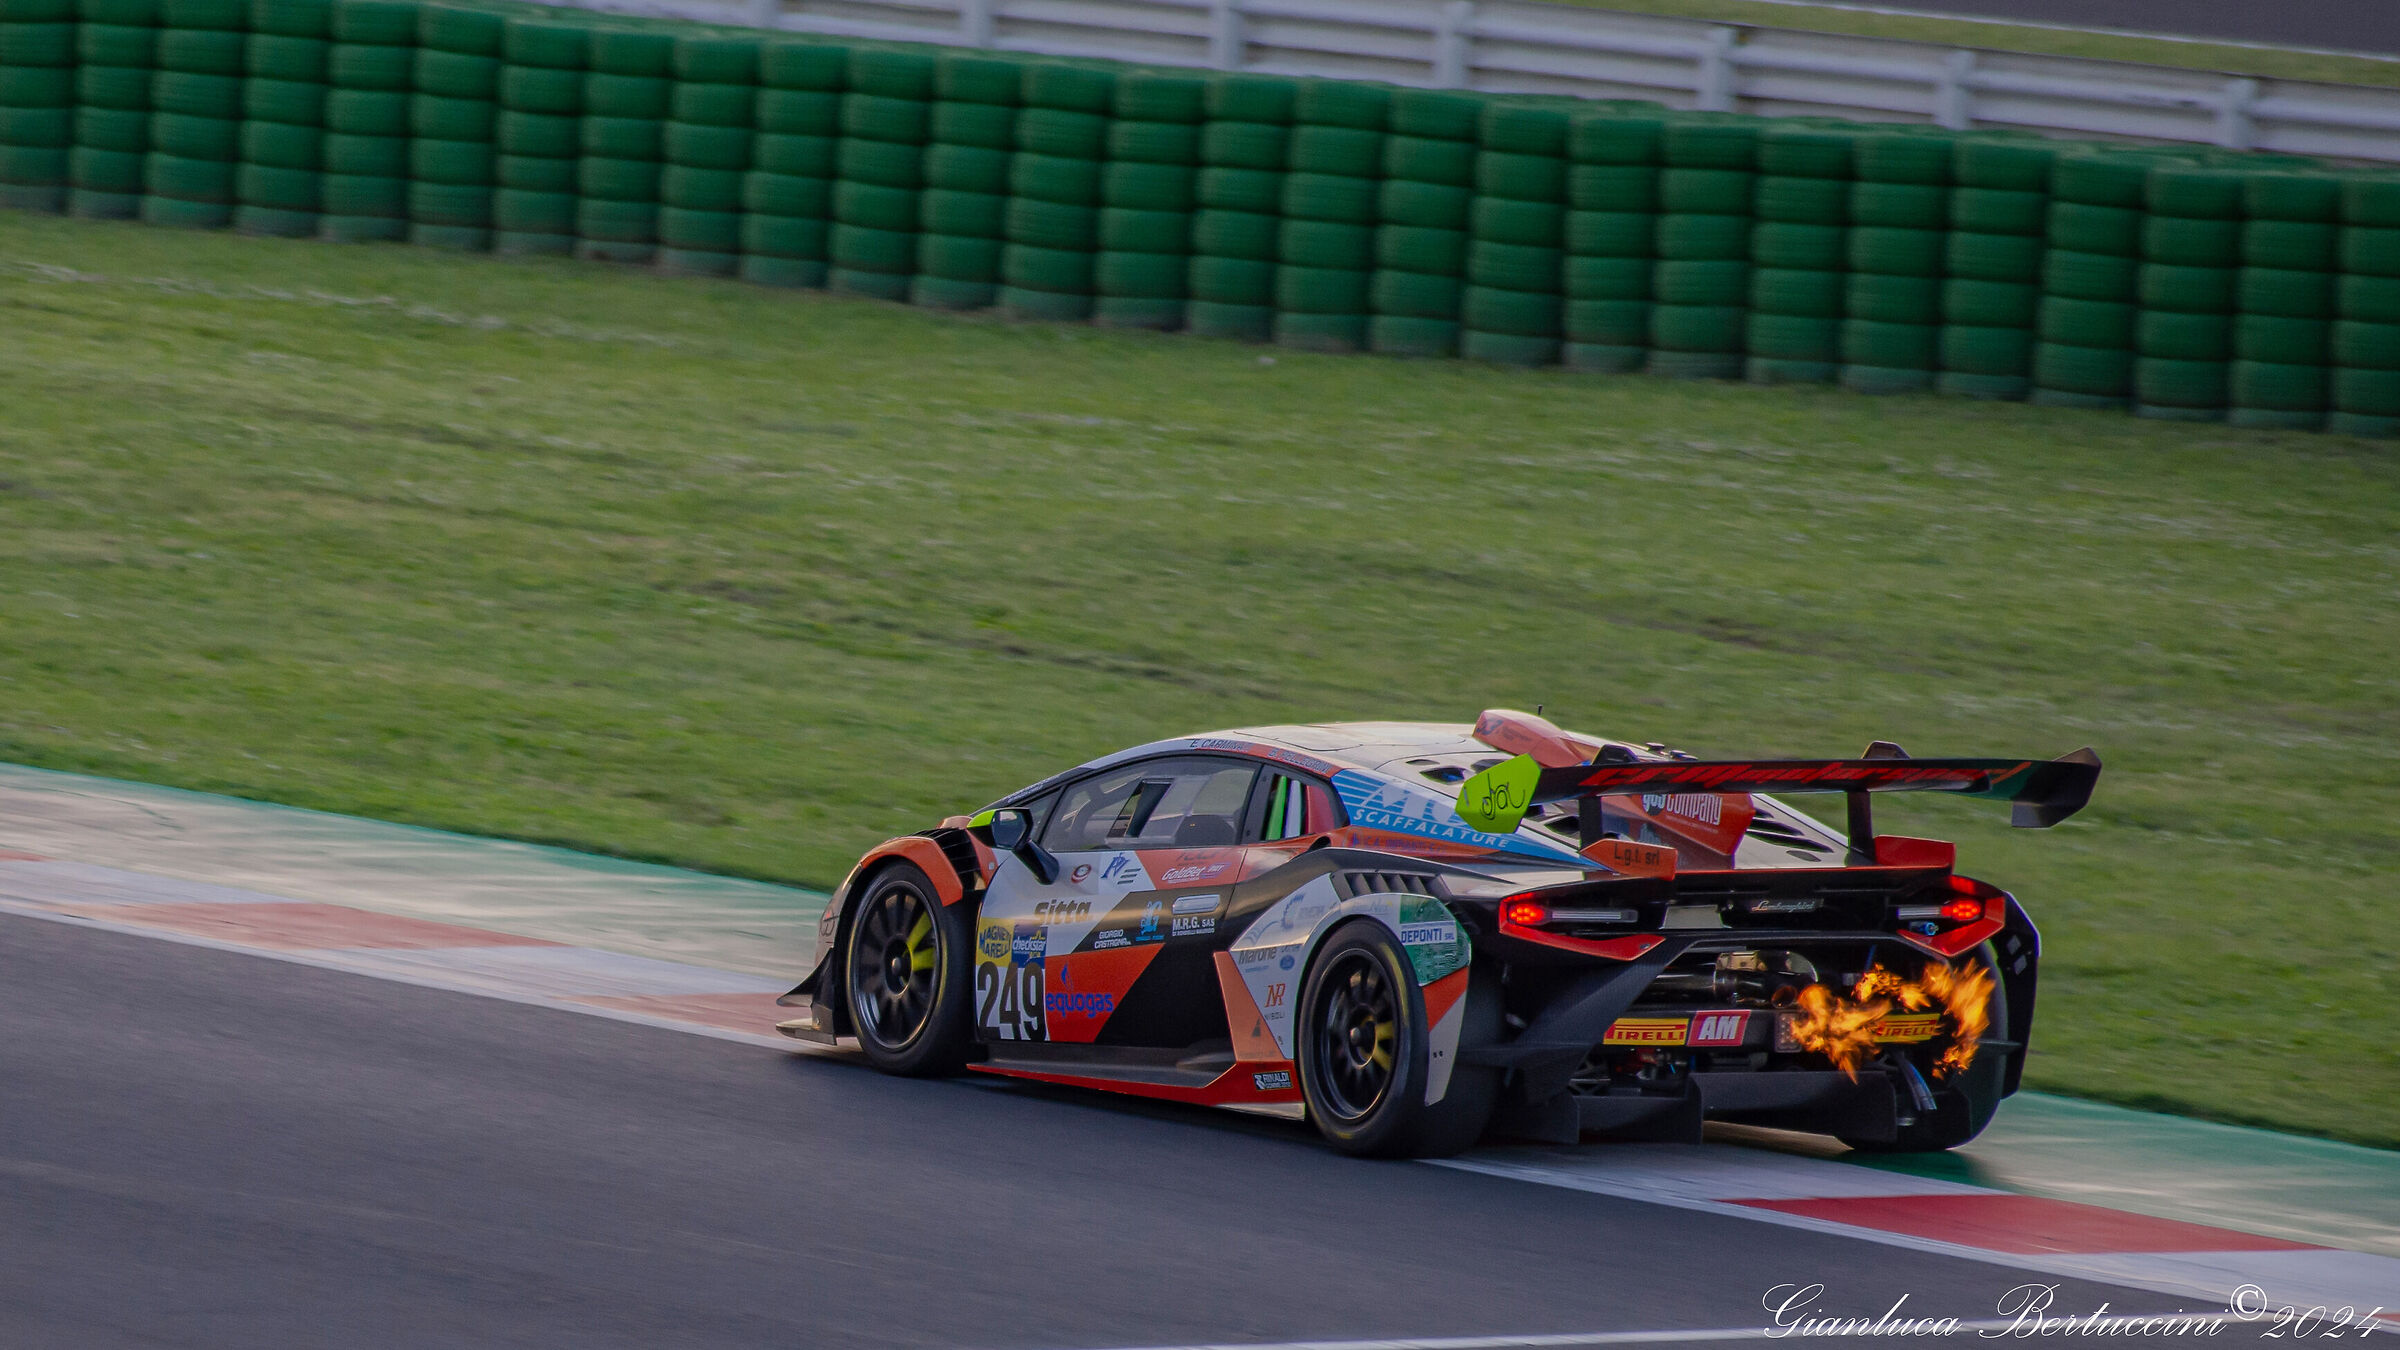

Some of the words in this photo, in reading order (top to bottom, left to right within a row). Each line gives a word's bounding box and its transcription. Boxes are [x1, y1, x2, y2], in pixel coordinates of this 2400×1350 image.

[1353, 808, 1509, 848] SCAFFALATURE
[1172, 917, 1200, 931] M.R.G.
[1400, 928, 1442, 943] DEPONTI
[976, 961, 1047, 1040] 249
[1046, 993, 1114, 1018] equogas
[1698, 1016, 1741, 1040] AM
